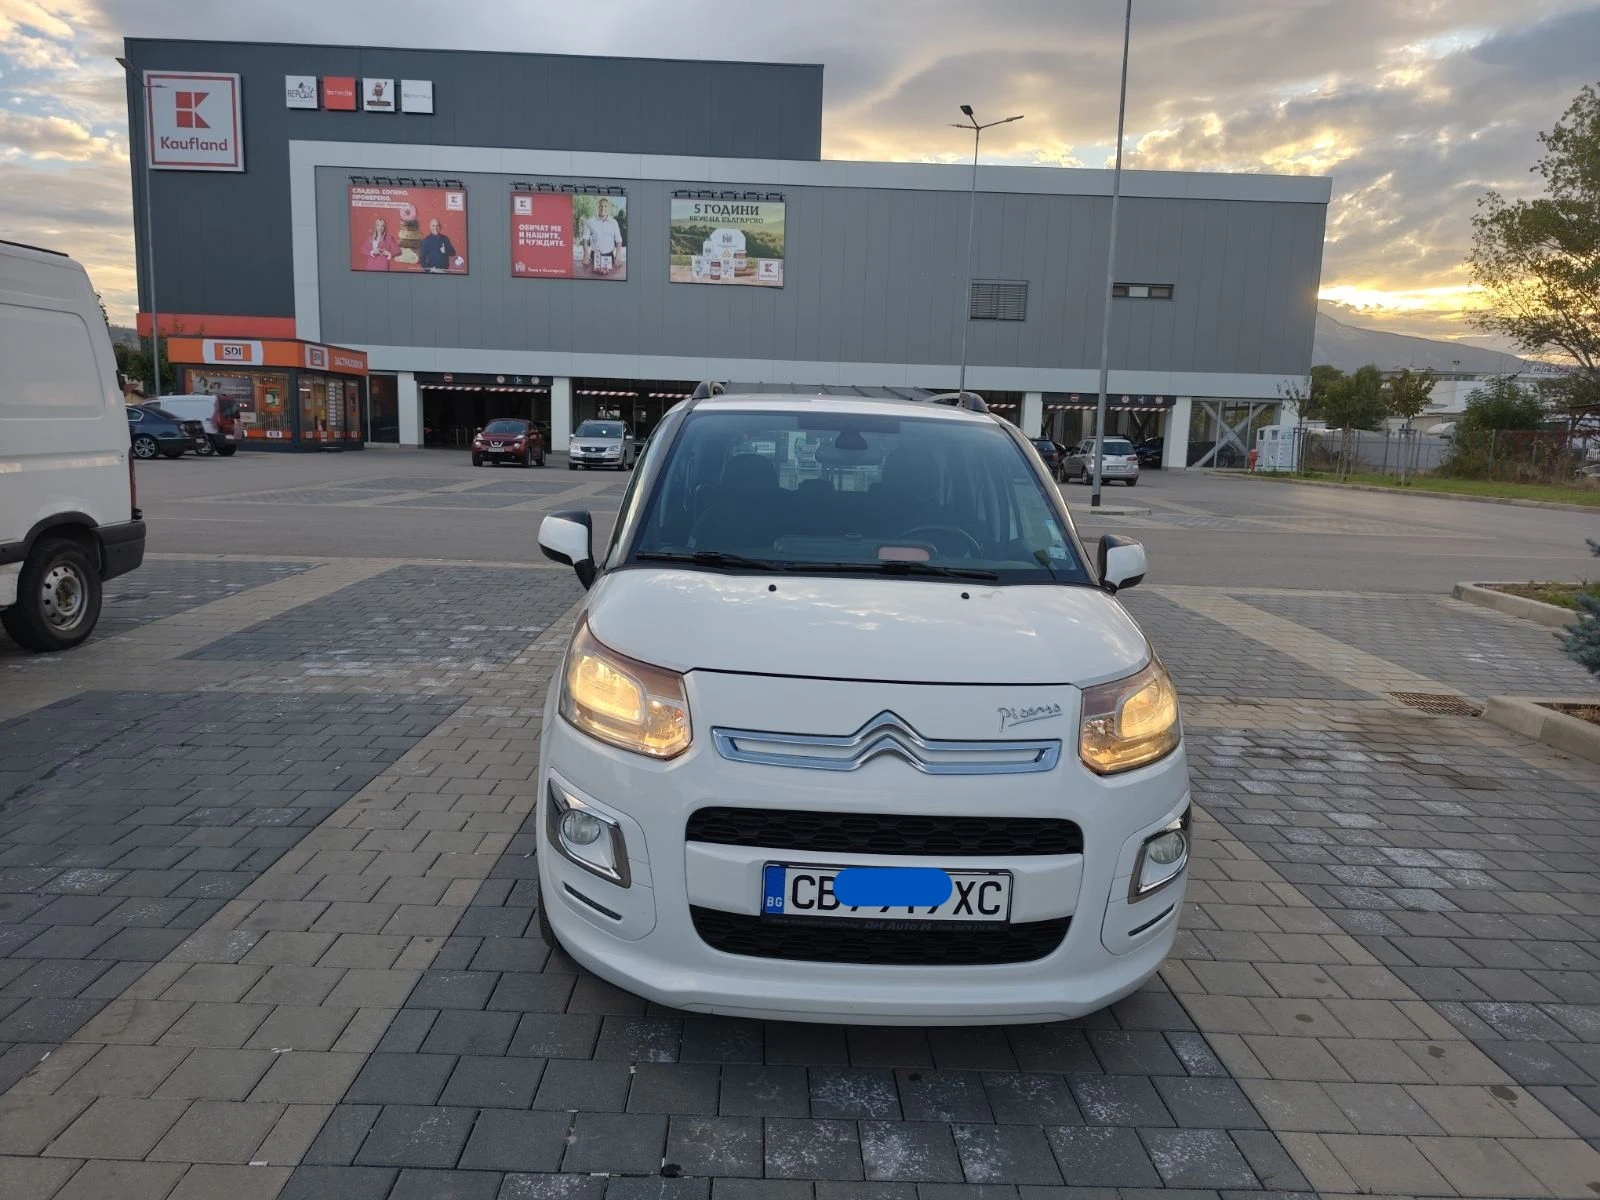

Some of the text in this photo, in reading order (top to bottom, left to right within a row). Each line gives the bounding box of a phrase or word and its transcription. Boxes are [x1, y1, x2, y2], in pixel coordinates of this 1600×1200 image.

[160, 136, 228, 151] Kaufland
[694, 204, 760, 216] 5 ГОДИНИ
[721, 217, 764, 225] БЪЛГАРСКО
[224, 346, 242, 356] SDI
[766, 896, 783, 908] BG
